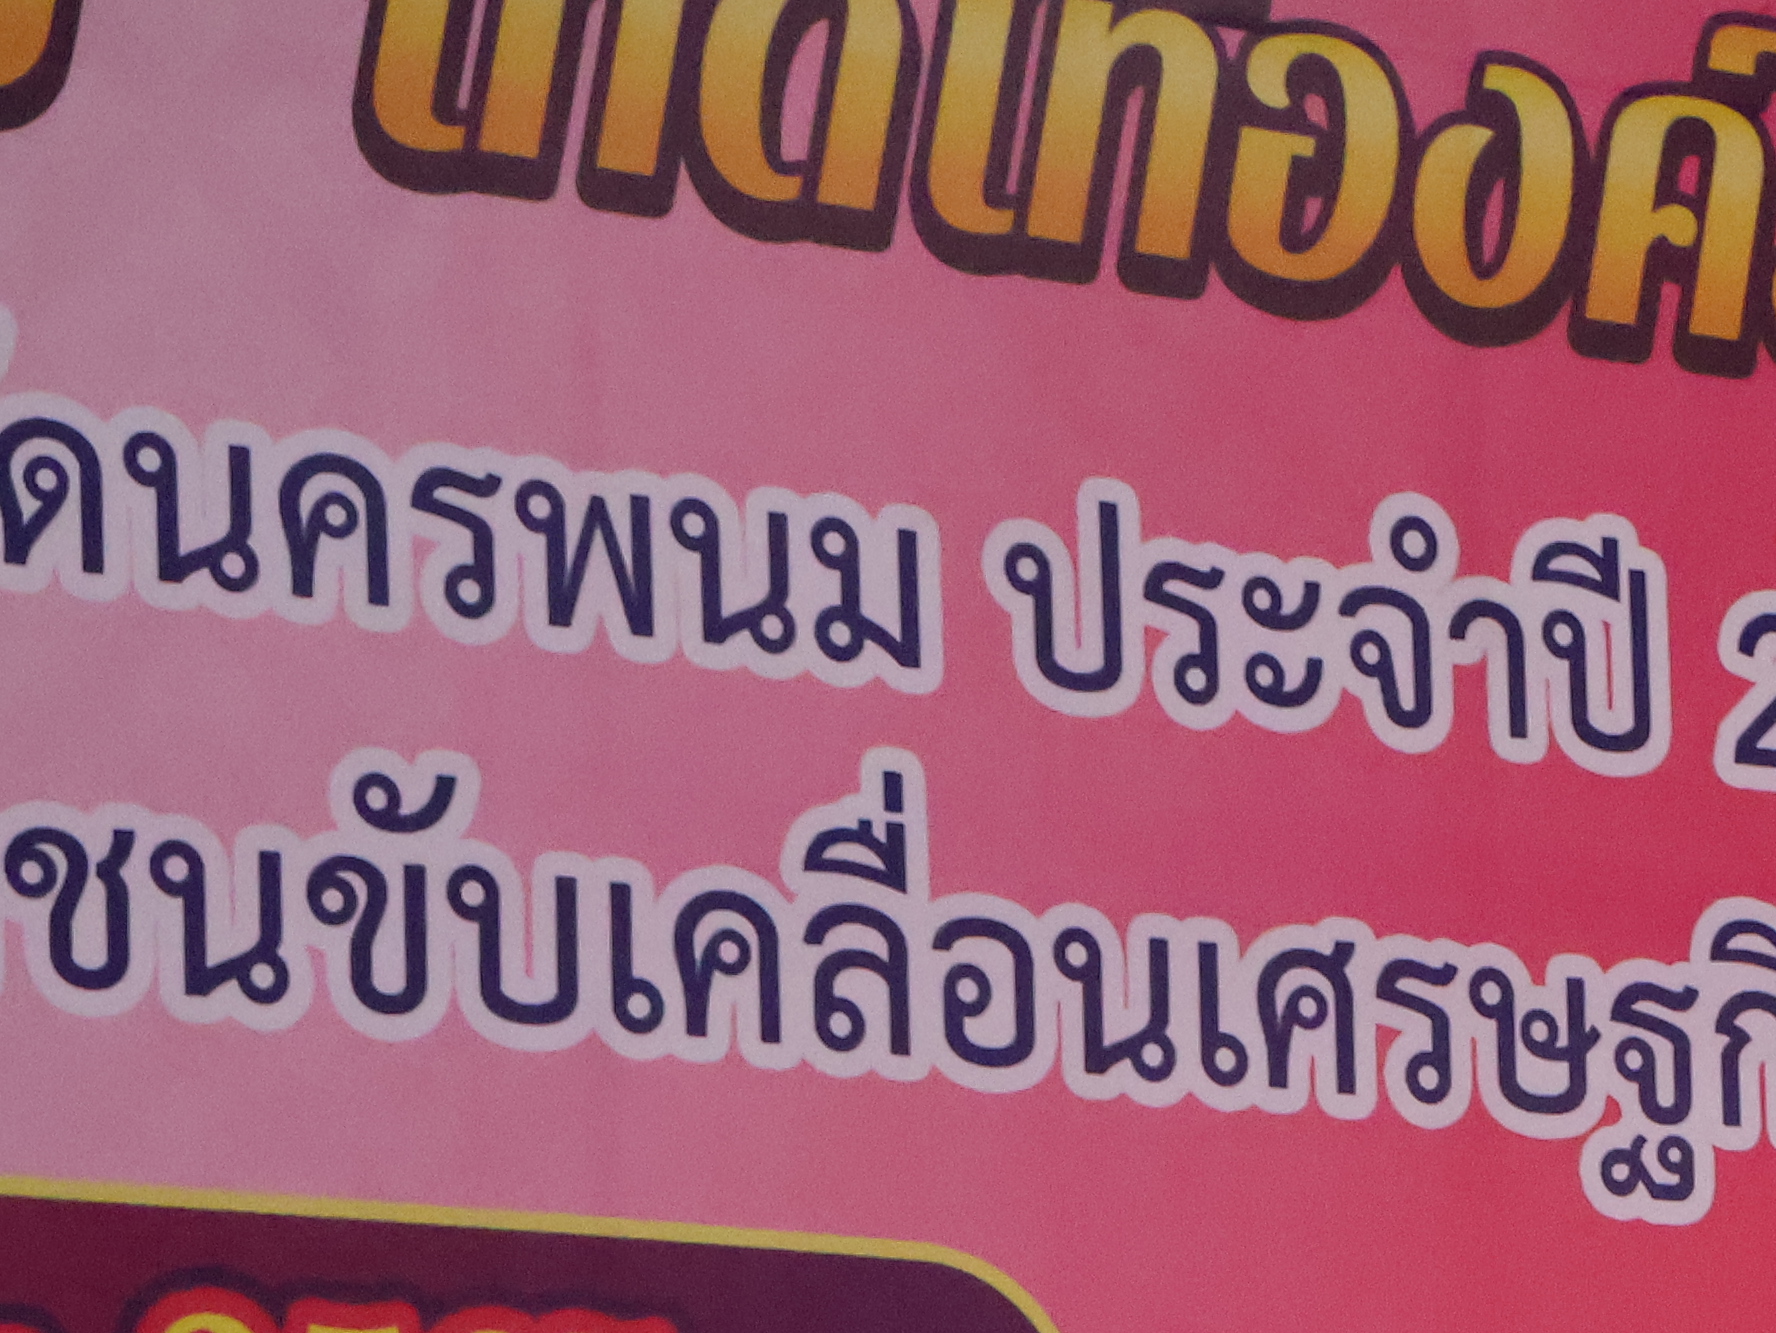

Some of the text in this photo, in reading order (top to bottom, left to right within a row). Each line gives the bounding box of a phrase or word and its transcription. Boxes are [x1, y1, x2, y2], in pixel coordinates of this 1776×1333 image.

[0, 415, 922, 668] ดนครพนม
[1003, 497, 1652, 753] ประจำปี
